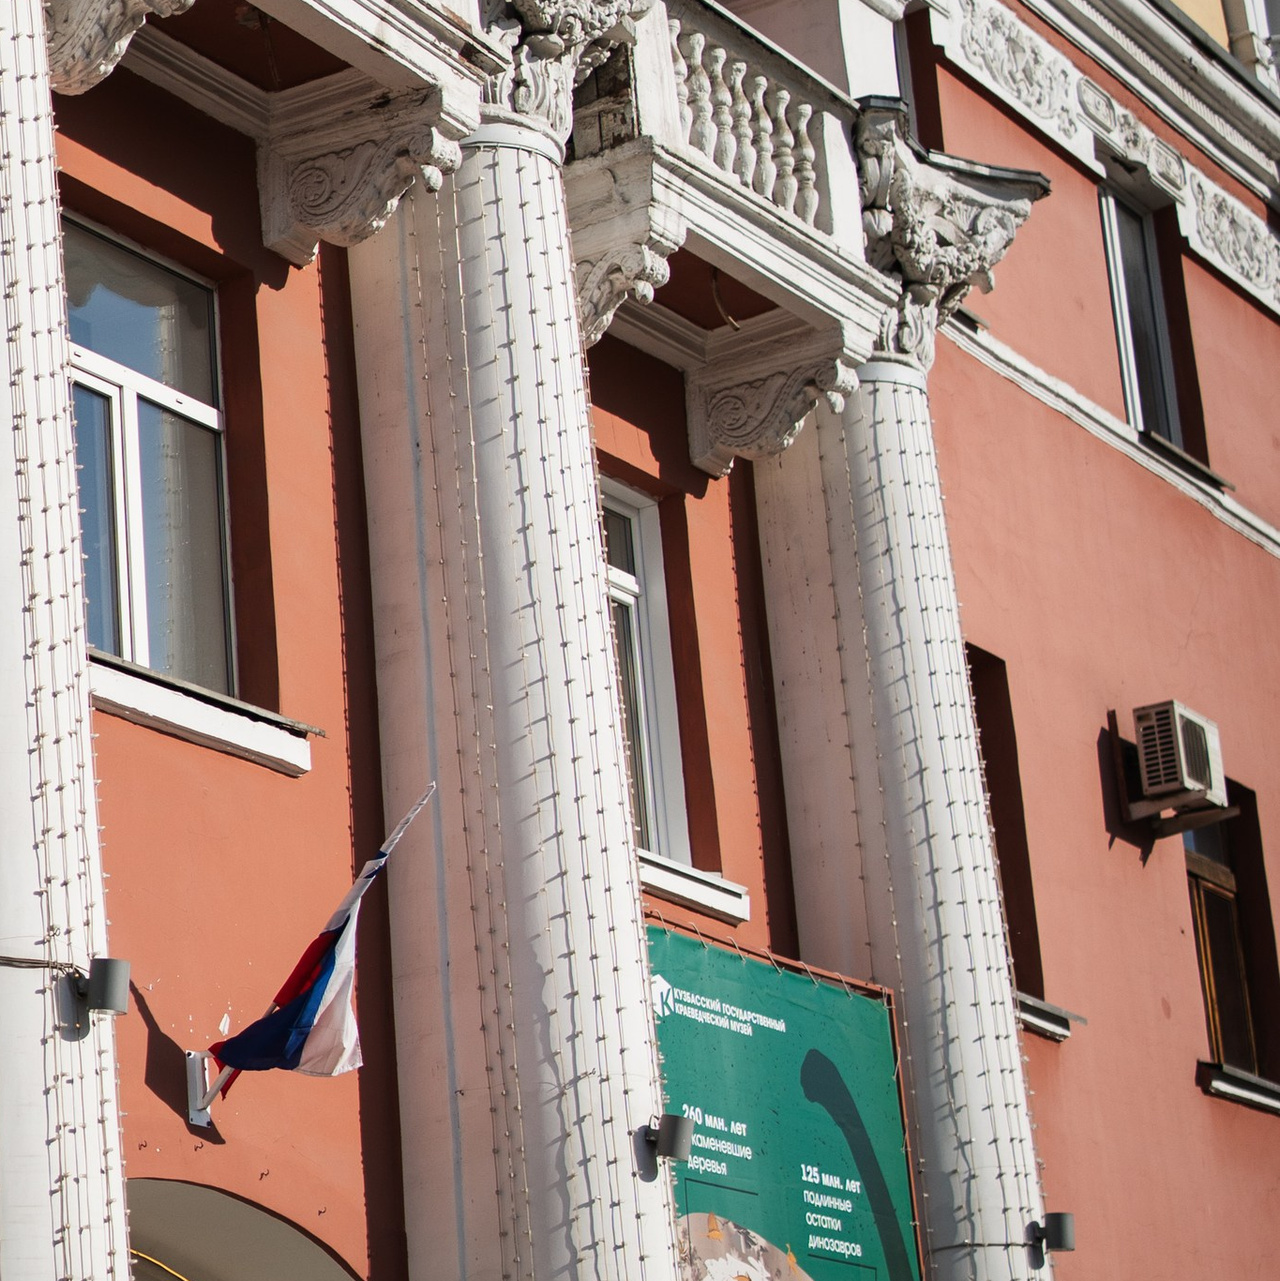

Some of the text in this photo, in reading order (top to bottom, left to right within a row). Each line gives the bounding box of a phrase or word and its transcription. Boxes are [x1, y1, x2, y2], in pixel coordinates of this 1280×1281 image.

[674, 987, 786, 1033] КУЗБАССКИЙ ГОСУДАРСТВЕННЫЙ
[675, 1002, 753, 1036] КРАЕВЕДЧЕСКИЙ МУЗЕЙ
[682, 1103, 702, 1125] 260
[730, 1121, 747, 1136] лет
[691, 1133, 752, 1160] каменевшие
[687, 1154, 727, 1176] деревья
[801, 1164, 820, 1184] 125
[845, 1179, 861, 1193] лет
[803, 1190, 852, 1213] подлинные
[805, 1212, 842, 1231] остатки
[808, 1234, 862, 1258] динозавров
